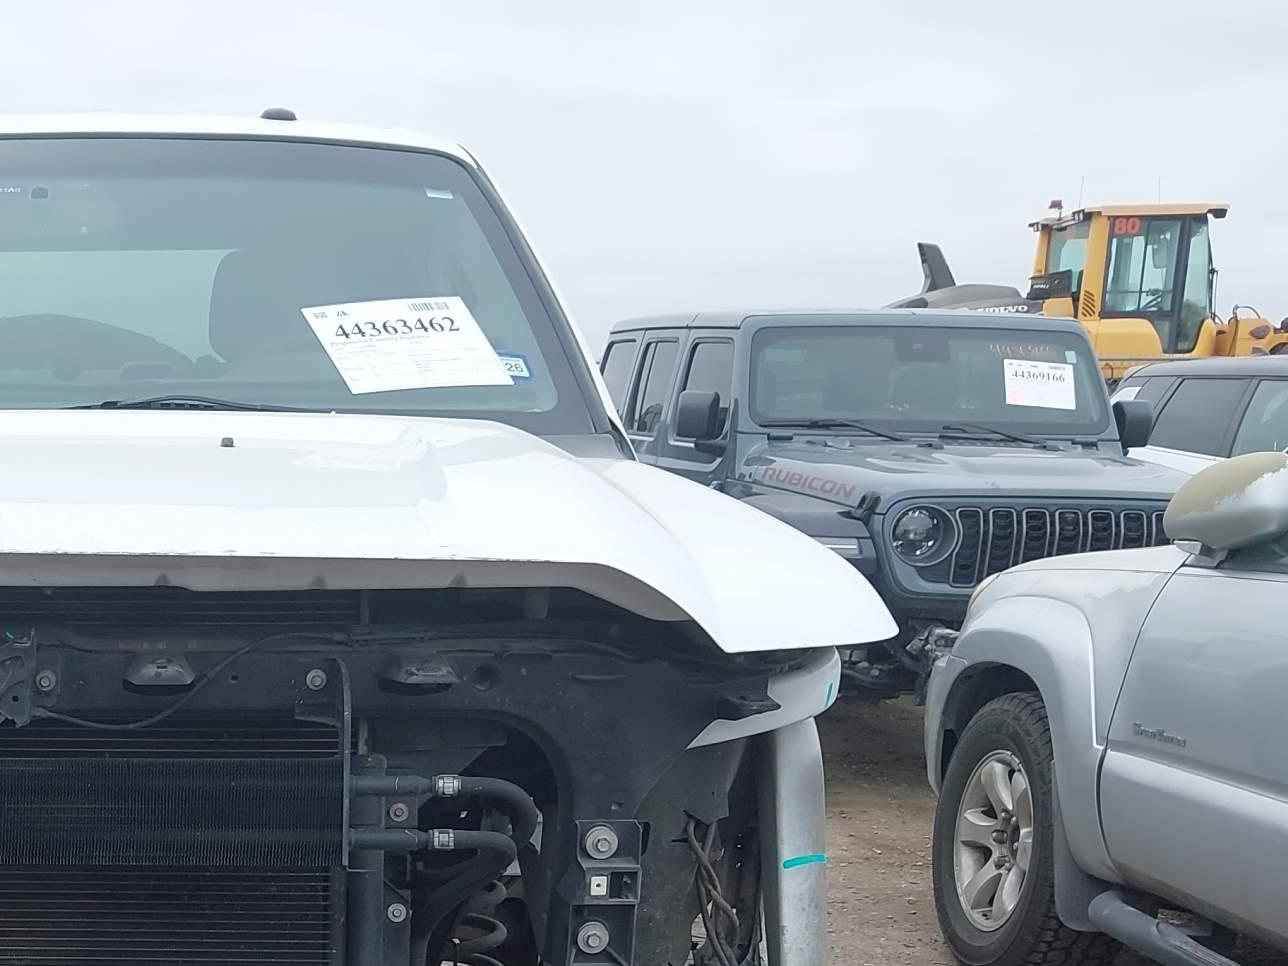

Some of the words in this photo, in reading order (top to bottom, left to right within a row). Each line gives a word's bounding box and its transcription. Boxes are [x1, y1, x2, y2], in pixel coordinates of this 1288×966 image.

[335, 316, 460, 339] 44363462
[504, 362, 524, 373] 26
[1011, 368, 1066, 383] 44369166
[761, 467, 857, 498] RUBICON
